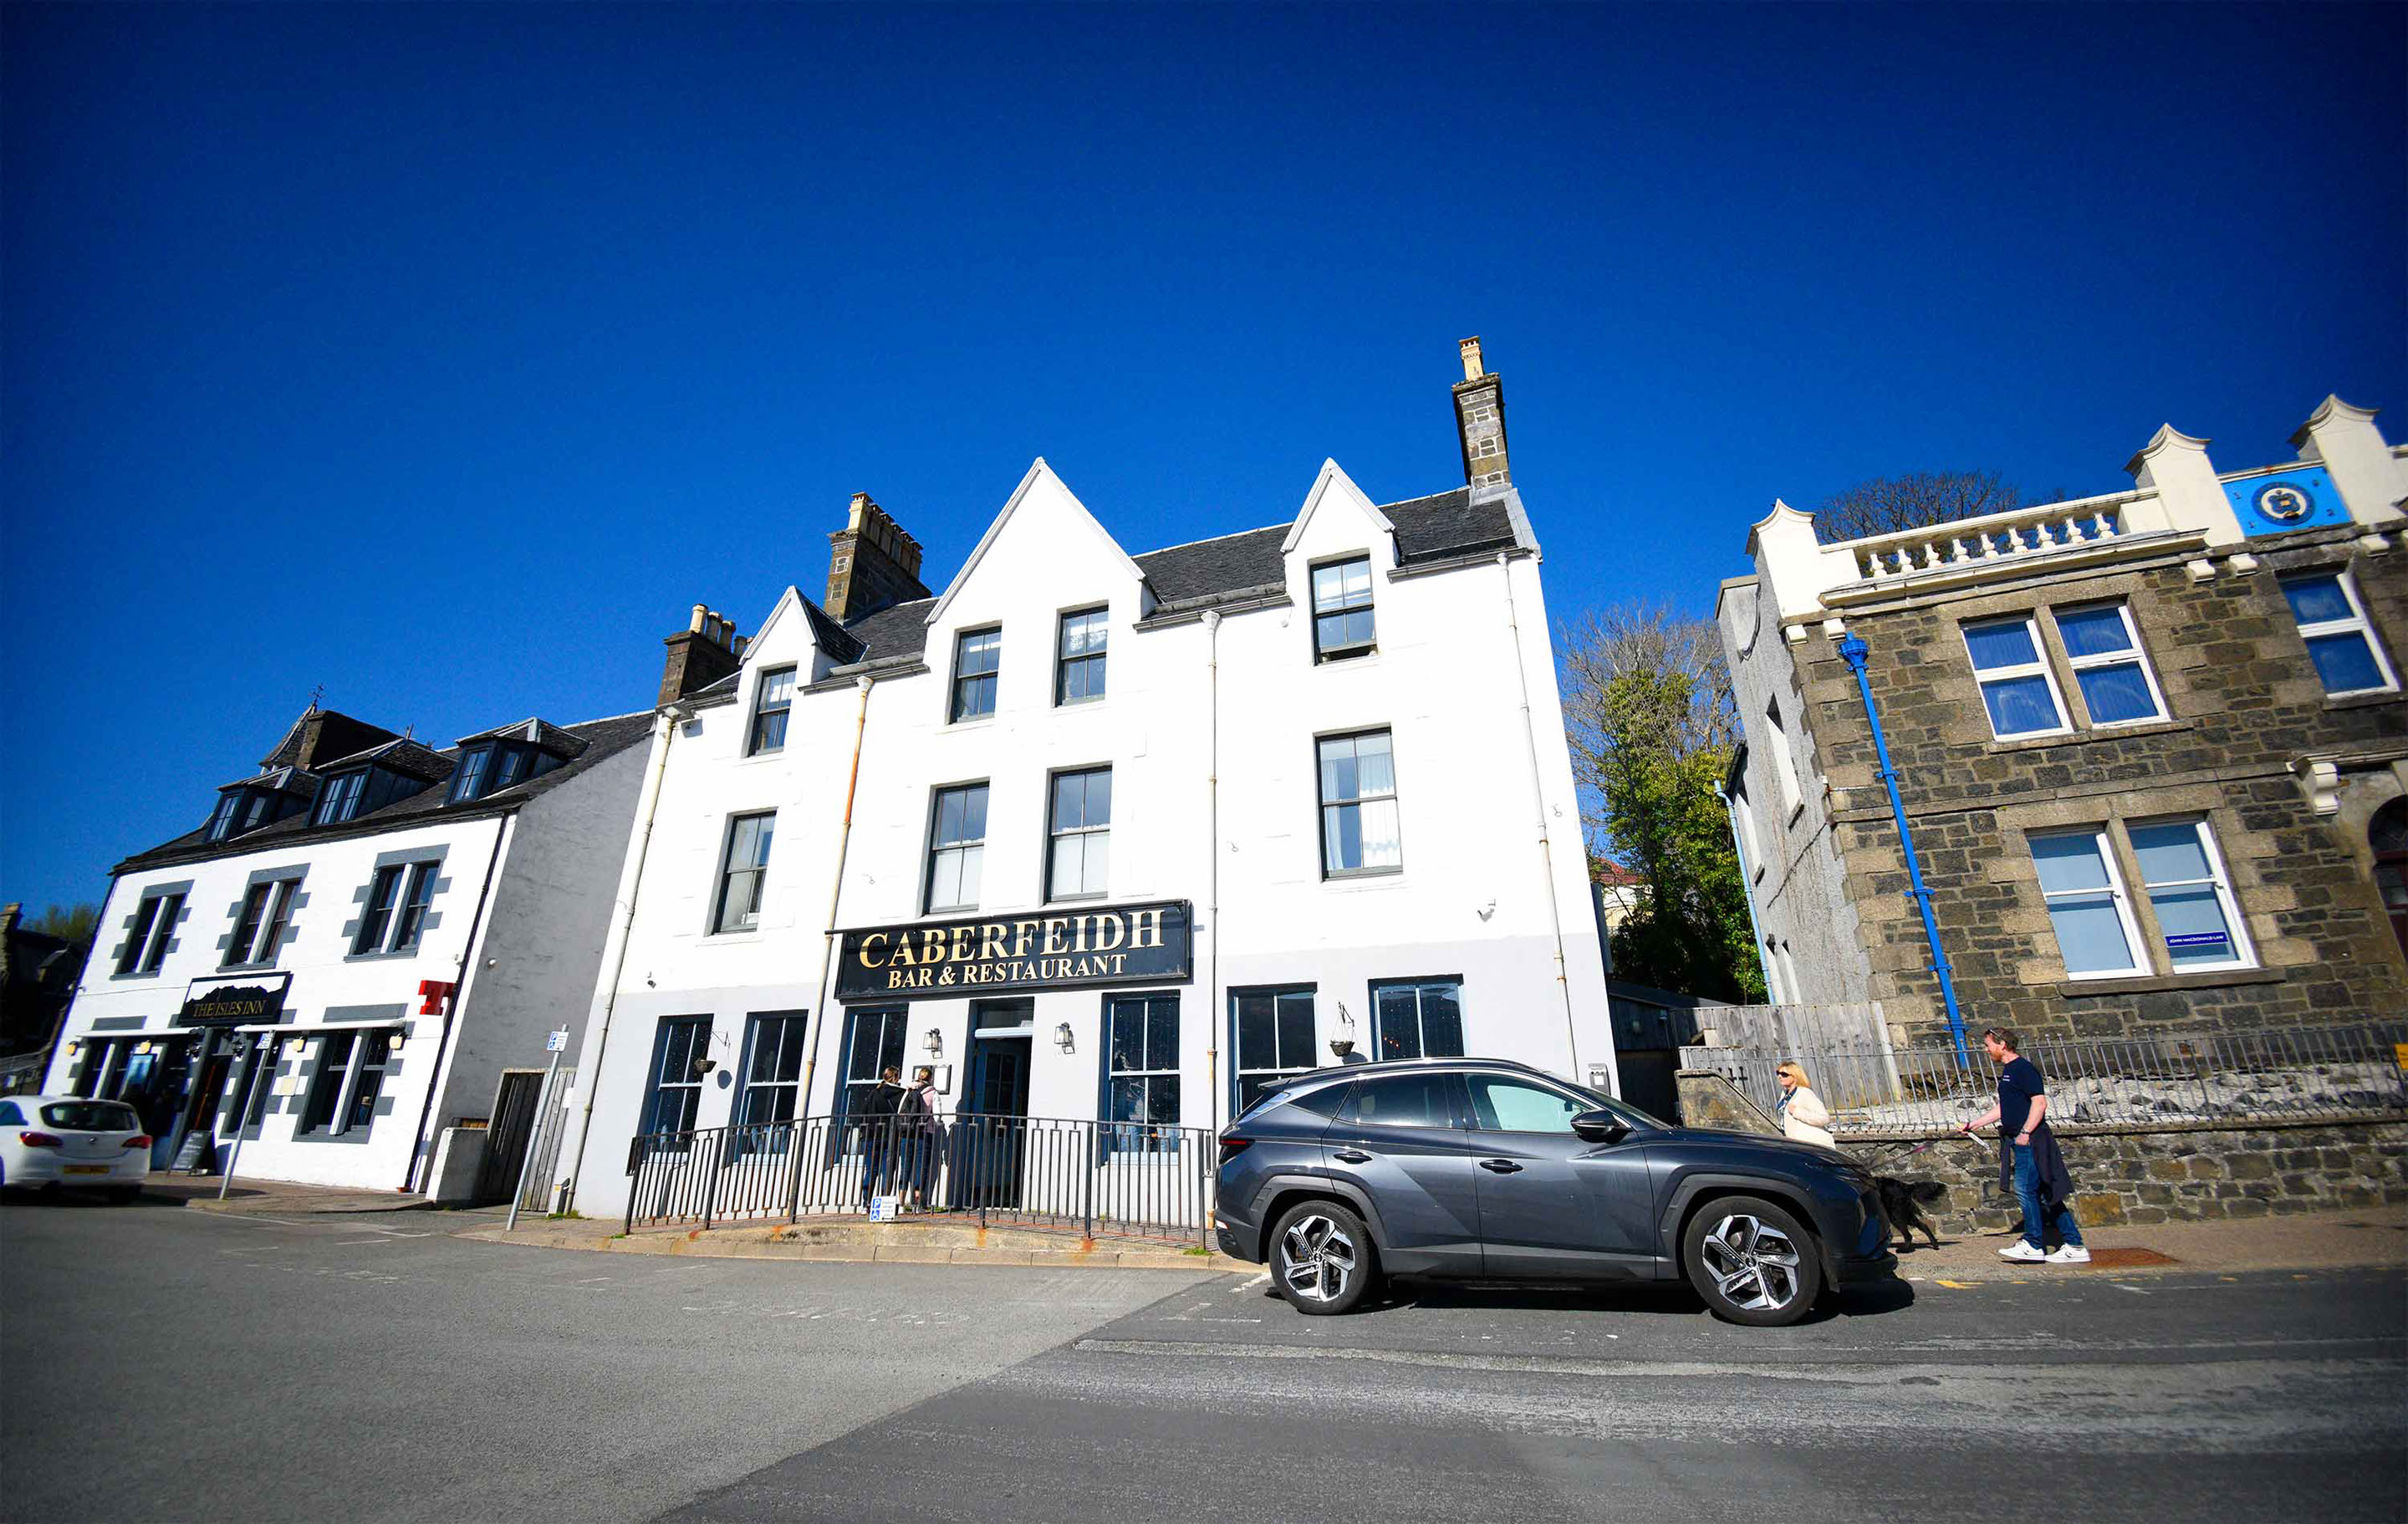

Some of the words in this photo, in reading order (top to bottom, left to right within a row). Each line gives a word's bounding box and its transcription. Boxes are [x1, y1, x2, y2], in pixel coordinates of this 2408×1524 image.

[860, 910, 1166, 969] CABERFEIDH
[887, 969, 934, 989] BAR
[938, 968, 957, 986] &
[962, 954, 1127, 984] RESTAURANT
[193, 1003, 214, 1017] THE
[214, 1002, 242, 1016] ISLES
[242, 1001, 267, 1015] INN
